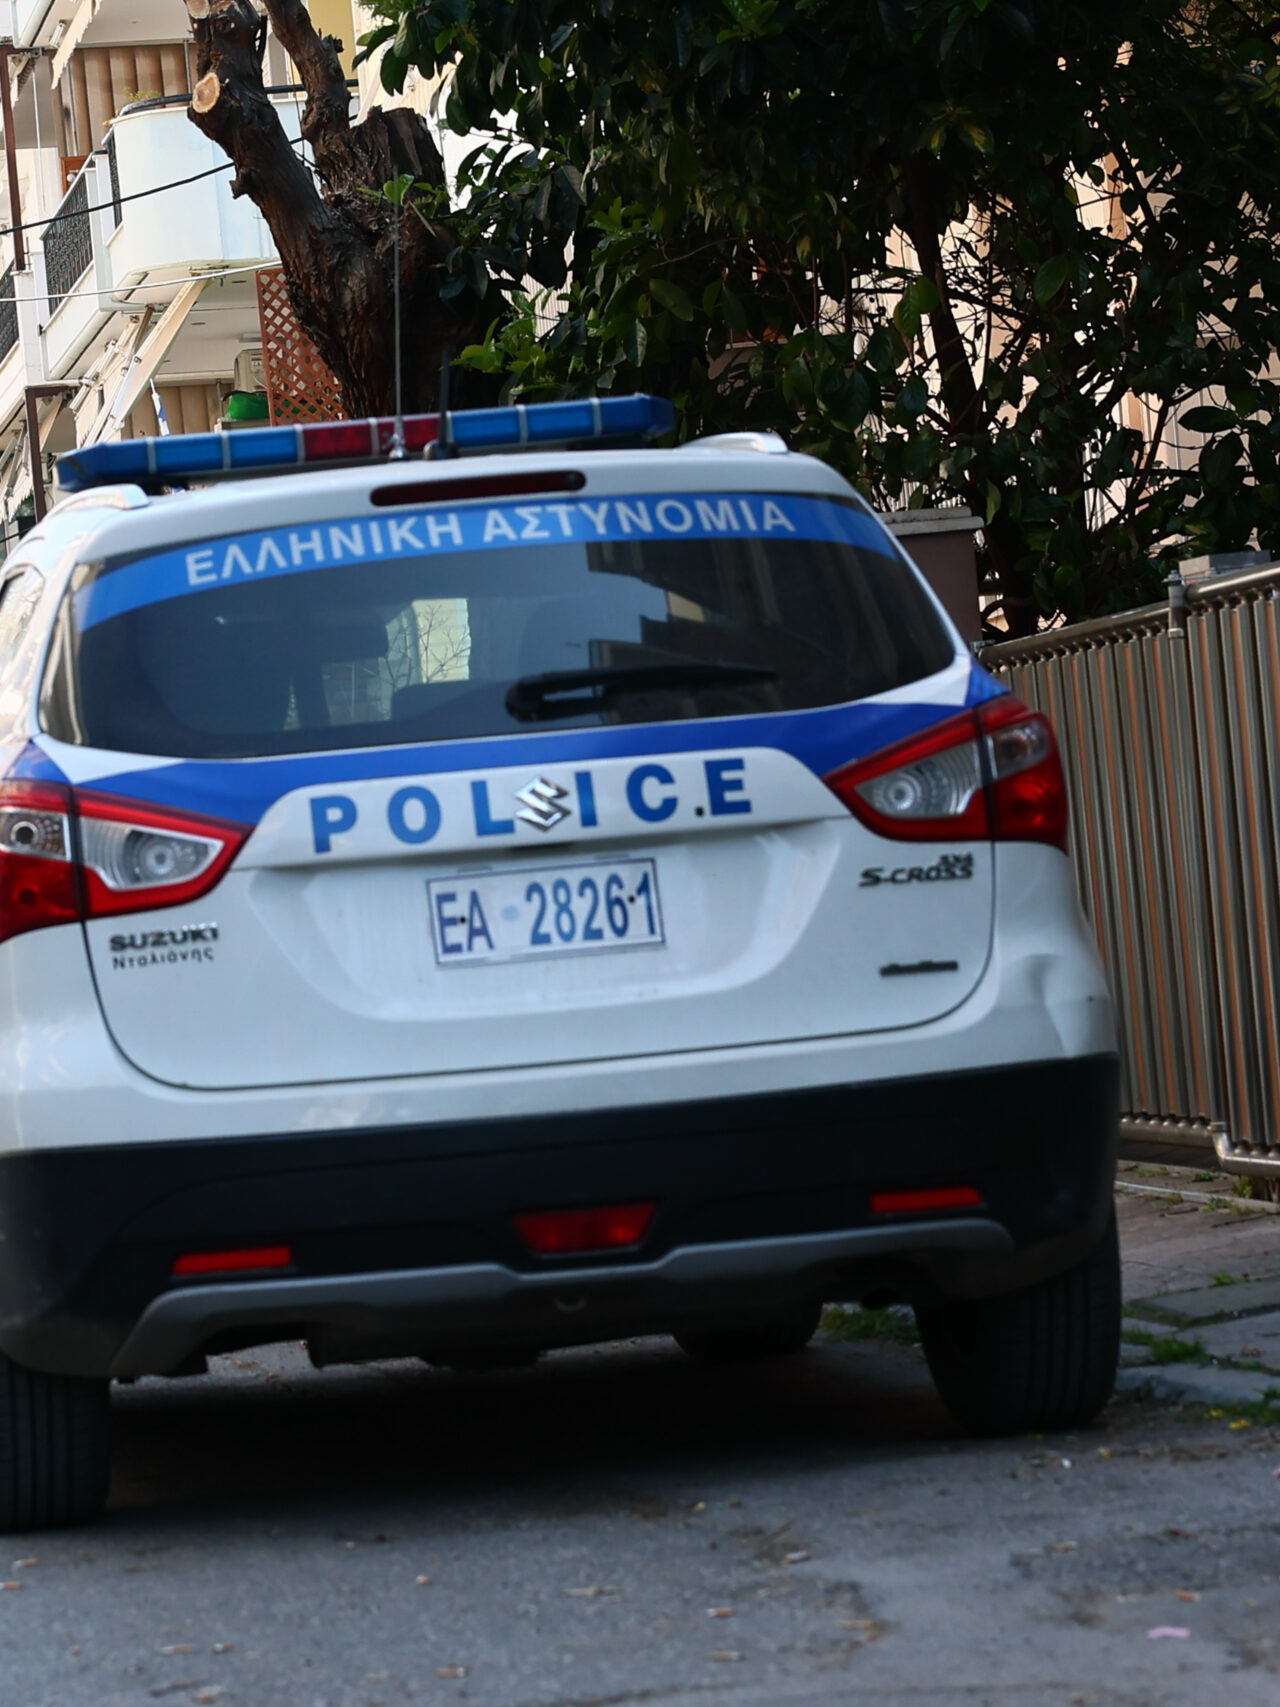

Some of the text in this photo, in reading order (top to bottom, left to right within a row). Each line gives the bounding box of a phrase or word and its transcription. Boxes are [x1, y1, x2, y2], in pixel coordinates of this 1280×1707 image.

[185, 499, 796, 586] ΕΛΛΗΝΙΚΗ ΑΣΤΥΝΟΜΙΑ
[309, 757, 752, 854] POLICE
[109, 924, 219, 952] SUZUKI
[525, 871, 657, 945] 28261
